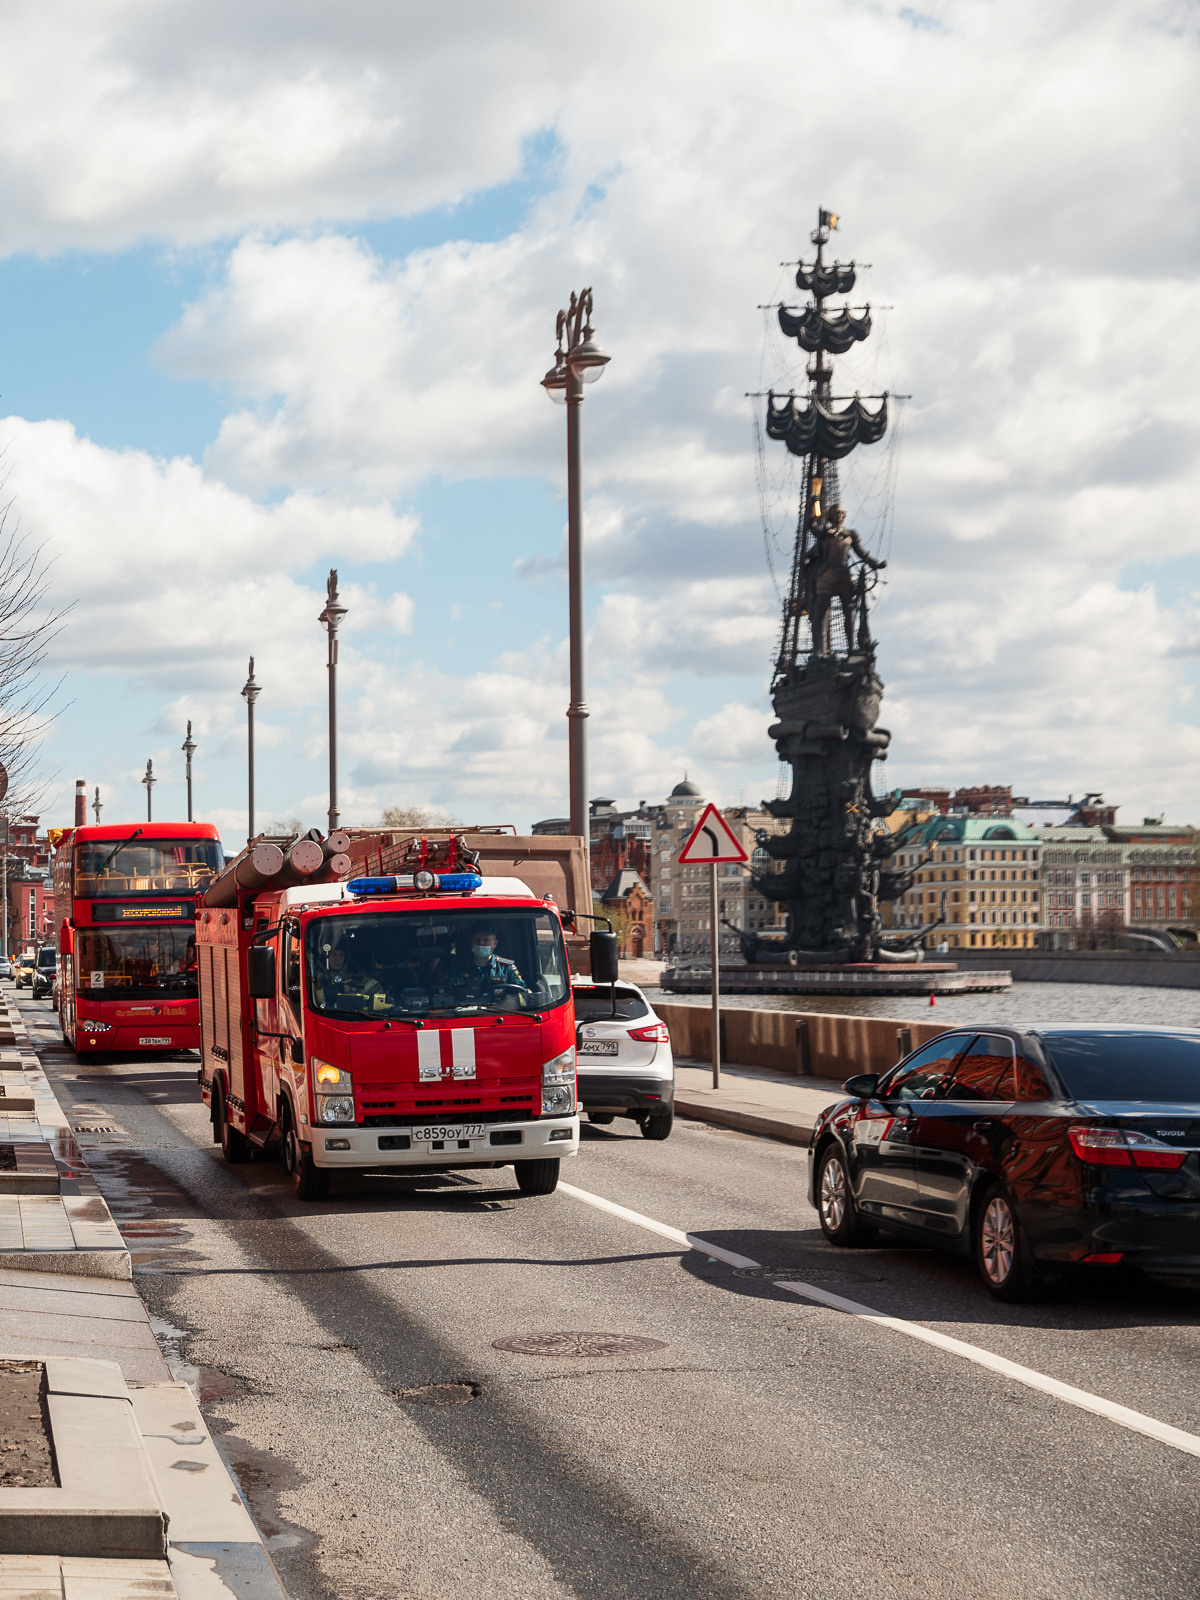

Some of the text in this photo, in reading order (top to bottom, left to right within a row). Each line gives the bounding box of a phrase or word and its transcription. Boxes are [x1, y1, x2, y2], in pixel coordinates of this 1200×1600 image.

[94, 973, 101, 982] 2
[420, 1065, 476, 1078] ISUZU
[415, 1125, 482, 1140] С859ОУ 777
